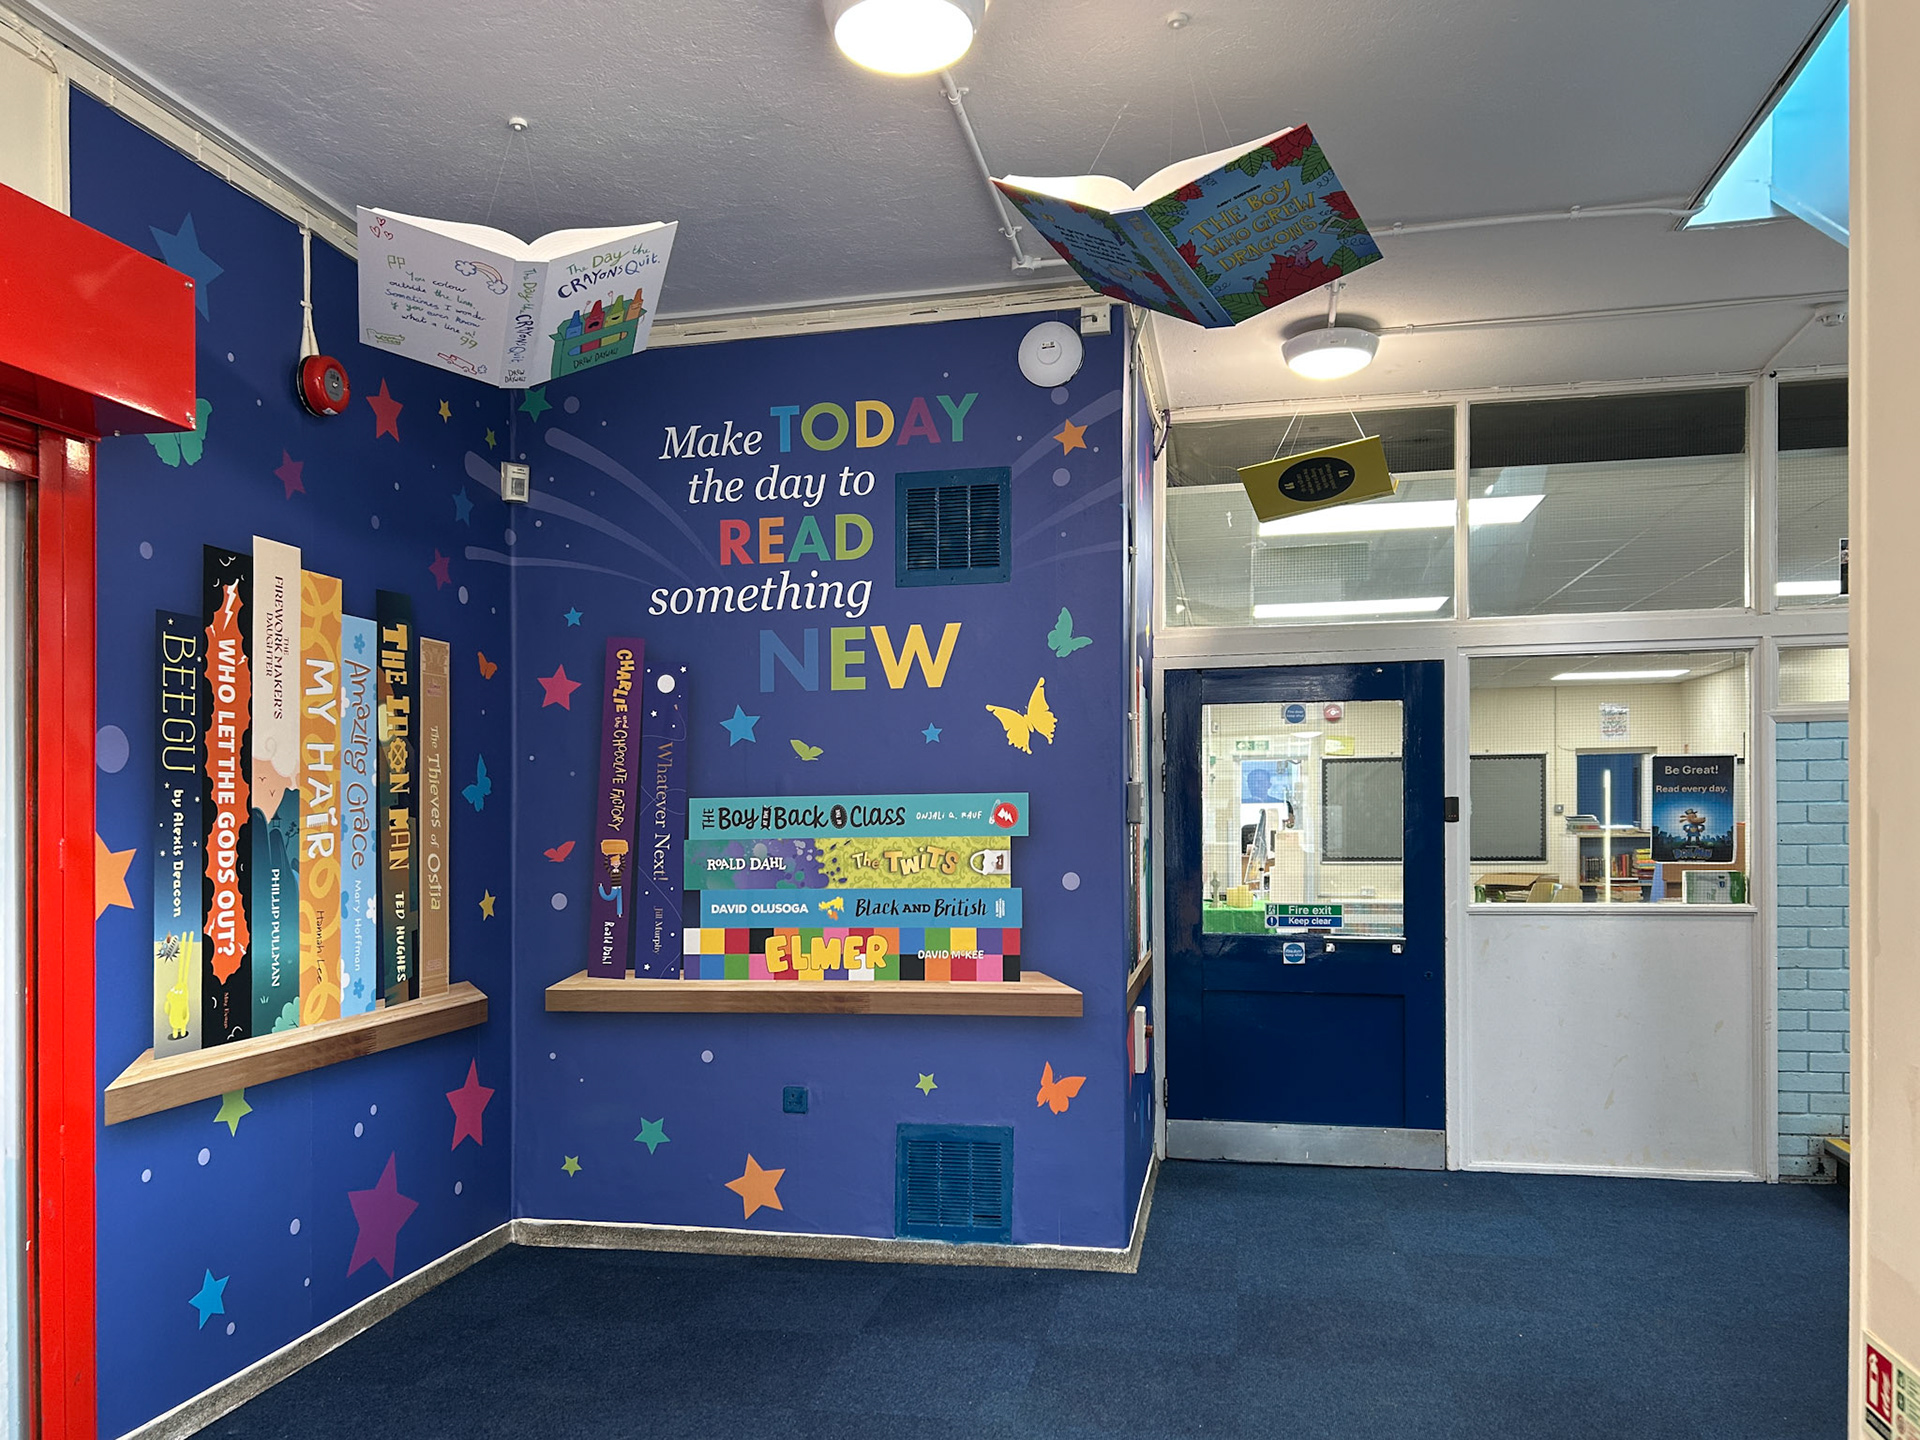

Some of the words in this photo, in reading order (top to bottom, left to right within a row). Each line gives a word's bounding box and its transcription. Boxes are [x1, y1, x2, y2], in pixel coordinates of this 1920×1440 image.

[1188, 205, 1248, 240] THE
[1244, 178, 1291, 213] BOY
[1201, 228, 1251, 258] WHO
[1252, 191, 1316, 233] GREW
[566, 263, 588, 276] The
[592, 250, 630, 268] Day
[632, 243, 651, 256] the
[1217, 215, 1318, 272] DRAGONS
[434, 289, 452, 301] the
[518, 282, 538, 302] Day
[558, 266, 624, 298] CRAYONS
[514, 314, 534, 349] CRAYONS
[658, 420, 763, 460] Make
[770, 392, 979, 453] TODAY
[688, 468, 744, 504] the
[755, 464, 826, 508] day
[838, 465, 876, 496] to
[719, 513, 874, 566] READ
[274, 576, 284, 653] FIREWORK
[648, 570, 872, 618] something
[265, 612, 274, 678] DAUGHTER
[382, 623, 408, 685] THE
[759, 622, 962, 692] NEW
[217, 639, 236, 704] WHO
[274, 655, 283, 720] MAKER'S
[306, 658, 336, 726] MY
[612, 649, 635, 713] CHARLIE
[162, 631, 197, 774] BEEGU
[344, 660, 372, 776] Amazing
[217, 713, 236, 753] LET
[430, 726, 439, 748] The
[612, 730, 628, 784] CHOCOLATE
[1664, 766, 1680, 775] Be
[1682, 765, 1719, 775] Great!
[171, 789, 184, 808] by
[217, 756, 236, 804] THE
[427, 753, 441, 828] Thieves
[654, 742, 674, 828] Whatever
[1656, 784, 1680, 793] Read
[1681, 786, 1708, 795] every
[1709, 784, 1728, 795] day.
[347, 782, 370, 870] Grace
[608, 788, 626, 832] FACTORY
[702, 808, 715, 830] THE
[718, 806, 760, 830] Boy
[774, 804, 828, 830] Back
[850, 805, 906, 828] Class
[961, 810, 982, 820] RAUF
[172, 812, 184, 856] Alexis
[217, 812, 236, 884] GODS
[389, 808, 410, 870] MAN
[431, 835, 440, 849] of
[653, 833, 671, 881] Next!
[706, 858, 746, 870] ROALD
[750, 857, 786, 870] DAHL
[852, 851, 880, 870] The
[172, 860, 184, 918] Deacon
[271, 868, 280, 918] PHILLIP
[351, 880, 362, 914] Mary
[428, 853, 442, 910] Ostia
[217, 890, 236, 956] OUT?
[396, 891, 405, 920] TED
[653, 905, 664, 919] Jill
[711, 904, 747, 914] DAVID
[750, 903, 808, 914] OLUSOGA
[856, 898, 900, 917] Black
[902, 904, 930, 912] AND
[934, 898, 988, 918] British
[1288, 906, 1309, 914] Fire
[1312, 906, 1332, 914] exit
[1288, 917, 1310, 926] Keep
[271, 921, 280, 987] PULLMAN
[316, 910, 326, 954] Hannah
[353, 918, 363, 972] Hoffman
[396, 926, 407, 982] HUGHES
[604, 921, 615, 944] Roald
[652, 921, 664, 954] Murphy
[764, 934, 889, 973] ELMER
[316, 959, 326, 984] Lee
[602, 946, 614, 965] Dahl
[918, 950, 949, 960] DAVID
